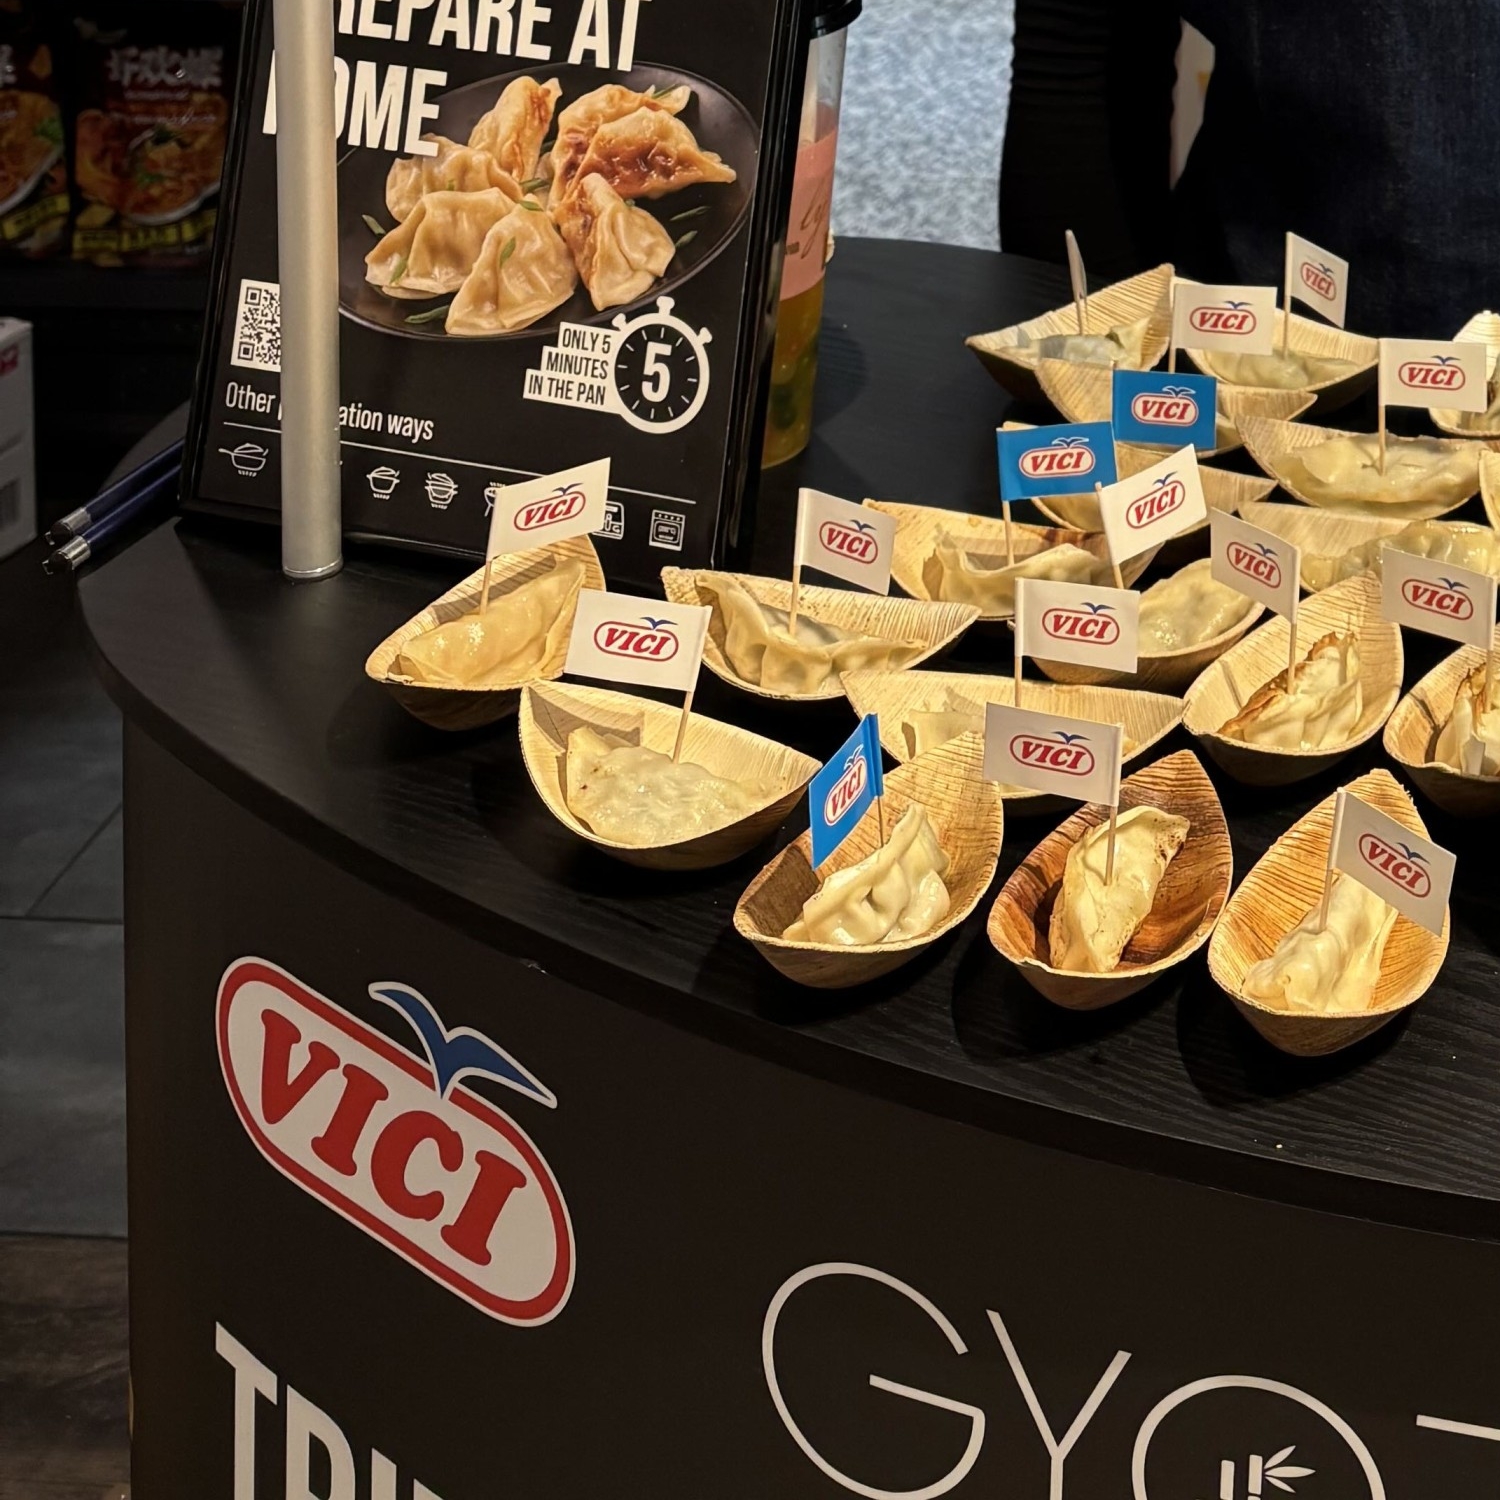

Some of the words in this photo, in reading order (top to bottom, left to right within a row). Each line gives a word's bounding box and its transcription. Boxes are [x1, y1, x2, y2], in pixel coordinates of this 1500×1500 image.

[263, 50, 448, 157] ME
[1303, 266, 1333, 298] VICI
[1197, 311, 1249, 332] VICI
[562, 327, 599, 351] ONLY
[602, 334, 611, 354] 5
[546, 350, 609, 380] MINUTES
[641, 341, 672, 402] 5
[1404, 365, 1458, 387] VICI
[528, 374, 543, 395] IN
[547, 377, 573, 400] THE
[577, 382, 606, 406] PAN
[225, 381, 276, 414] Other
[387, 413, 434, 444] ways
[1138, 398, 1191, 422] VICI
[1030, 449, 1088, 473] VICI
[524, 496, 579, 526] VICI
[1133, 489, 1179, 521] VICI
[826, 526, 874, 559] VICI
[1231, 547, 1277, 584] VICI
[1409, 584, 1468, 616] VICI
[602, 627, 671, 657] VICI
[1049, 614, 1113, 640] VICI
[1021, 740, 1087, 771] VICI
[831, 767, 863, 813] VICI
[1365, 841, 1424, 889] VICI
[260, 1008, 528, 1267] VICI
